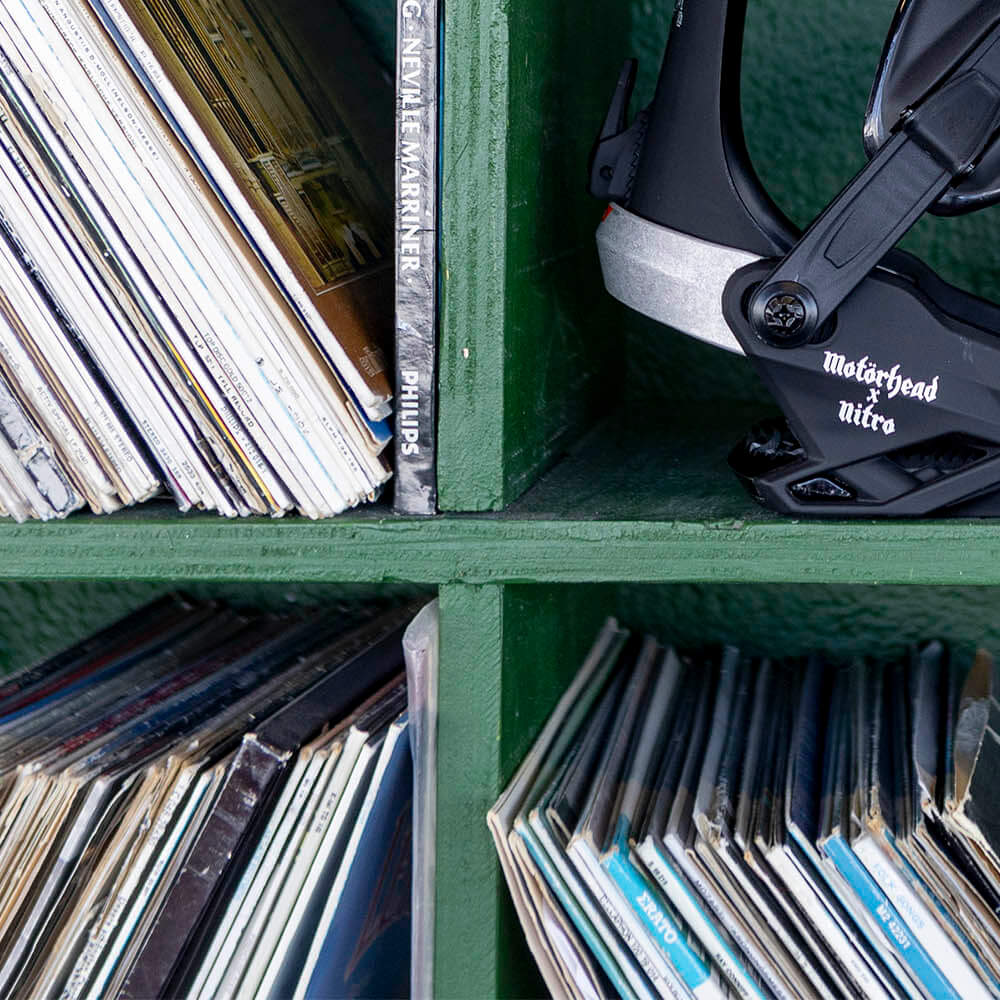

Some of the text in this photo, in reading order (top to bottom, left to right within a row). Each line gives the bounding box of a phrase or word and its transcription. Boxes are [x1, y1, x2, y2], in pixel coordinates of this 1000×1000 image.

[400, 38, 421, 134] NEVILLE
[400, 149, 421, 271] MARRINER
[823, 350, 939, 402] Motörhead
[866, 387, 880, 403] x
[401, 369, 420, 457] PHILIPS
[838, 400, 896, 435] Nitro
